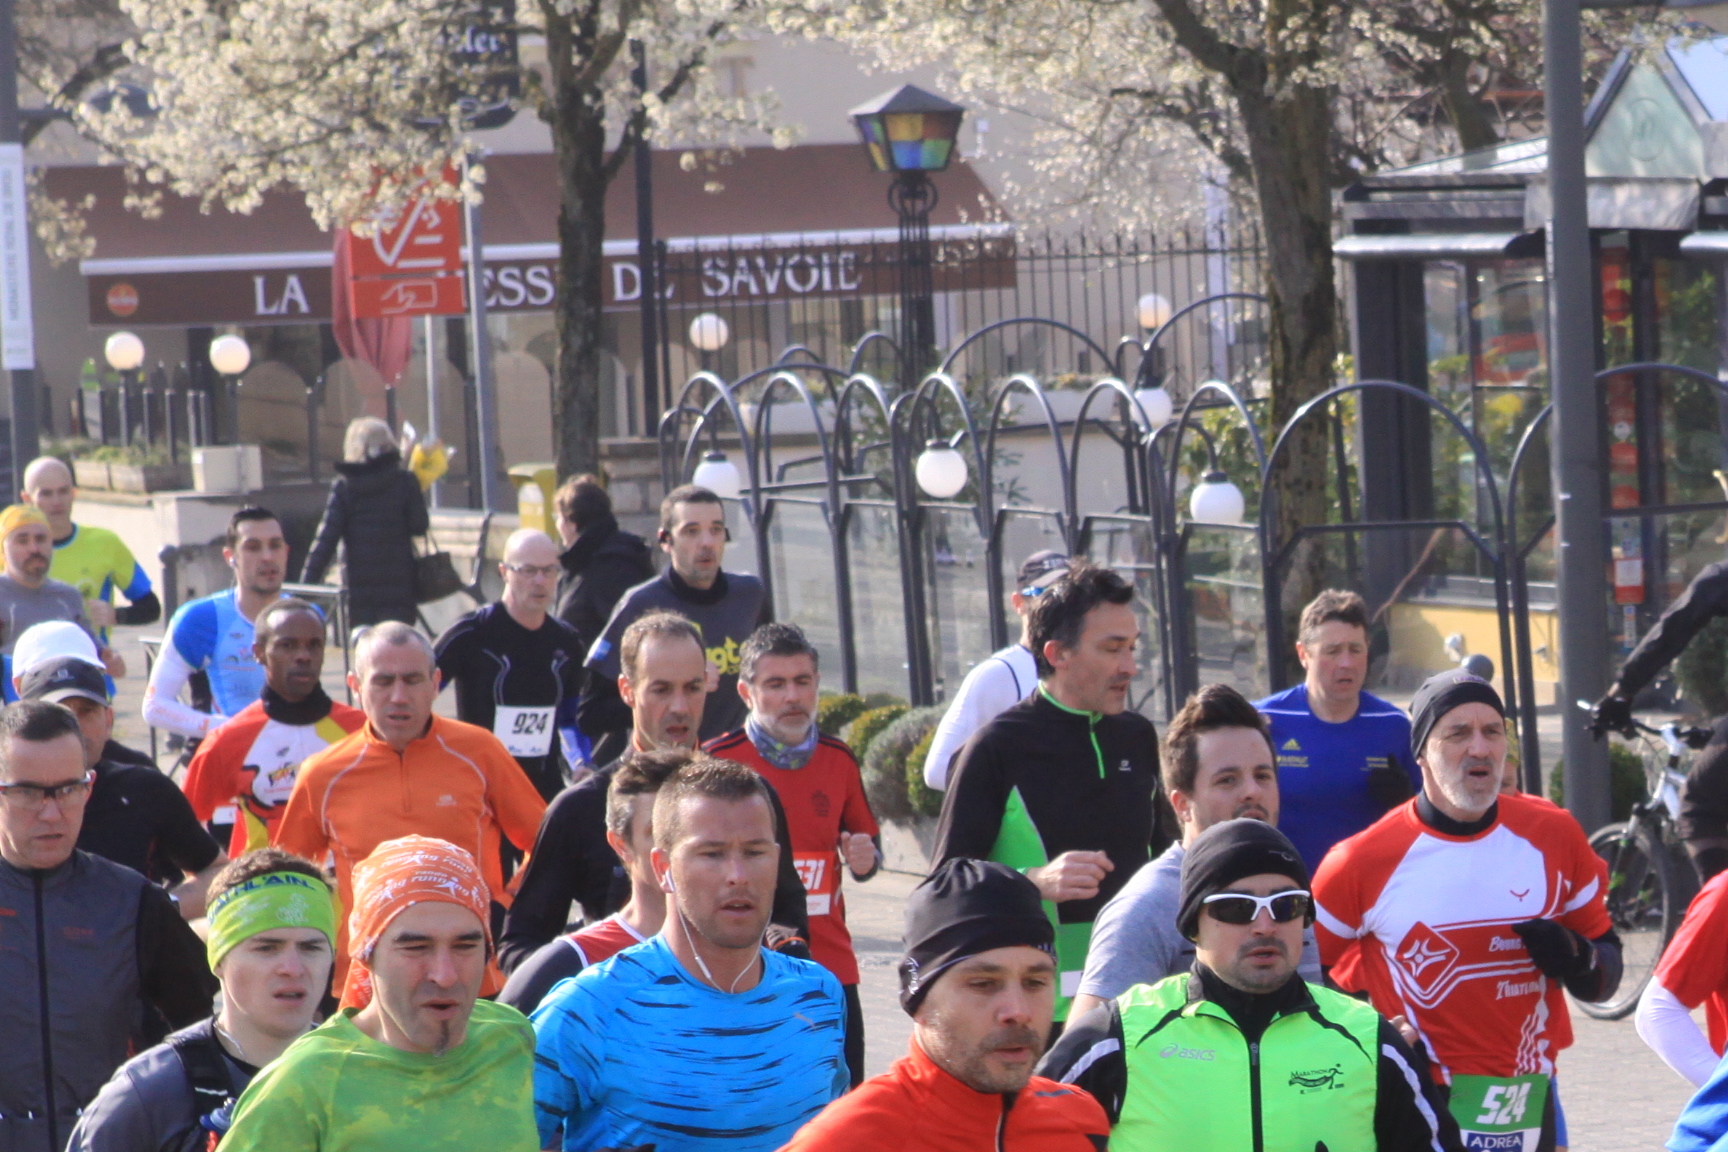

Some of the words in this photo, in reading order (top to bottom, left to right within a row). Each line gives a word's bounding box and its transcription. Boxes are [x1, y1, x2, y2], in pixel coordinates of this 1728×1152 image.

[254, 274, 310, 316] LA
[512, 713, 549, 735] 924
[1475, 1082, 1532, 1125] 524
[1470, 1135, 1522, 1149] ADREA
